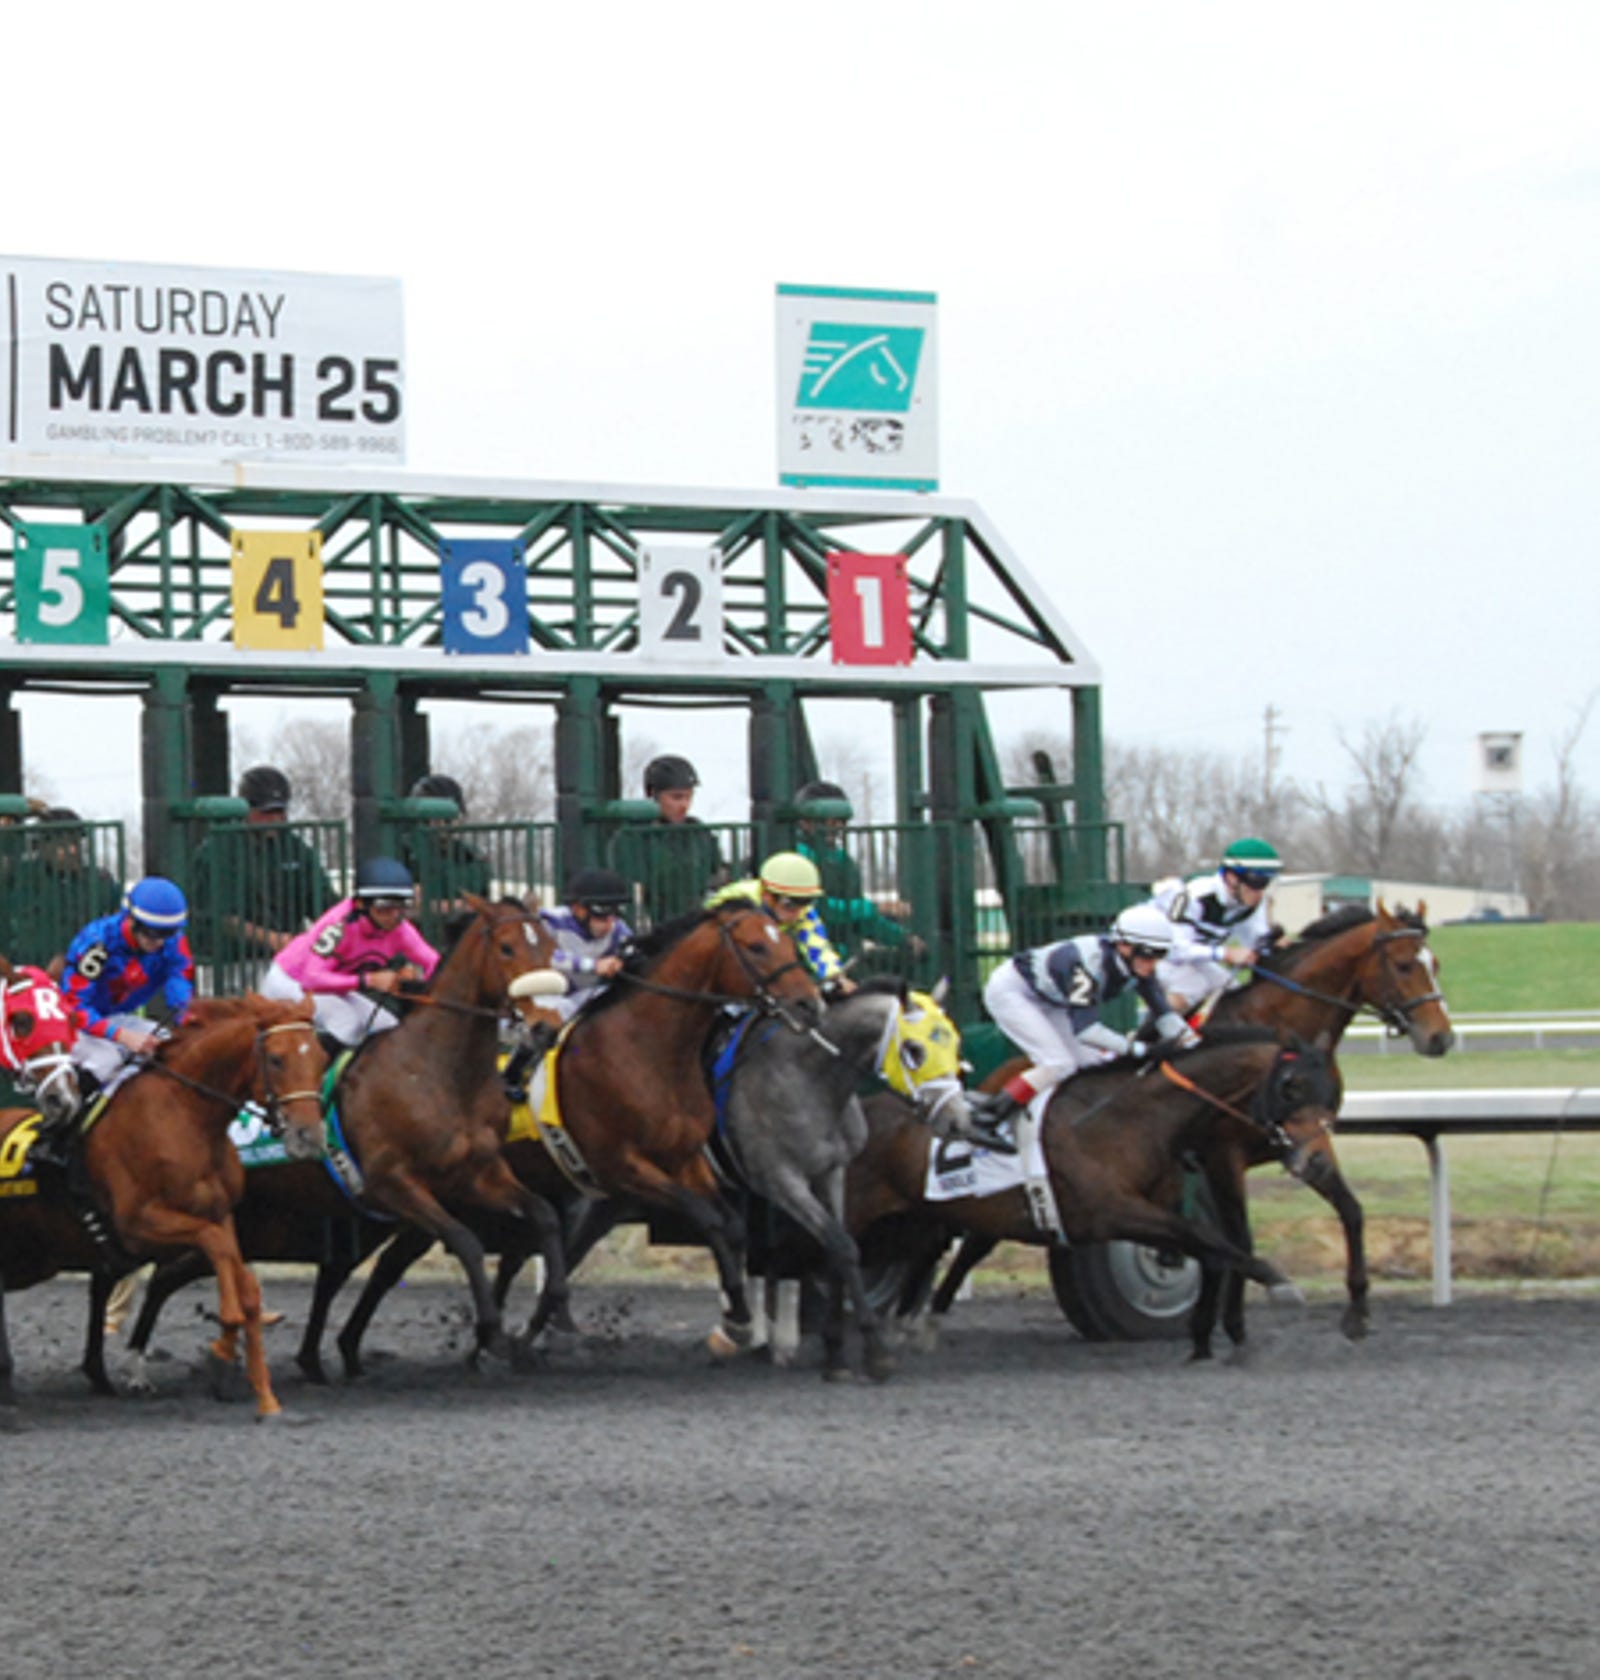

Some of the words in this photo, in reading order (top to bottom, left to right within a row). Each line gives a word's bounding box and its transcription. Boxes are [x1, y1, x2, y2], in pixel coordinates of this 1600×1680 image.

[45, 281, 285, 339] SATURDAY
[49, 342, 295, 420] MARCH
[315, 355, 401, 425] 25
[46, 423, 129, 443] GAMBLING
[133, 427, 217, 446] PROBLEM?
[37, 549, 84, 627] 5
[254, 558, 300, 629] 4
[459, 561, 511, 638] 3
[659, 571, 702, 641] 2
[854, 577, 883, 648] 1
[78, 949, 108, 978] 6
[313, 924, 343, 955] 5
[32, 987, 66, 1020] R
[1069, 964, 1096, 1004] 2
